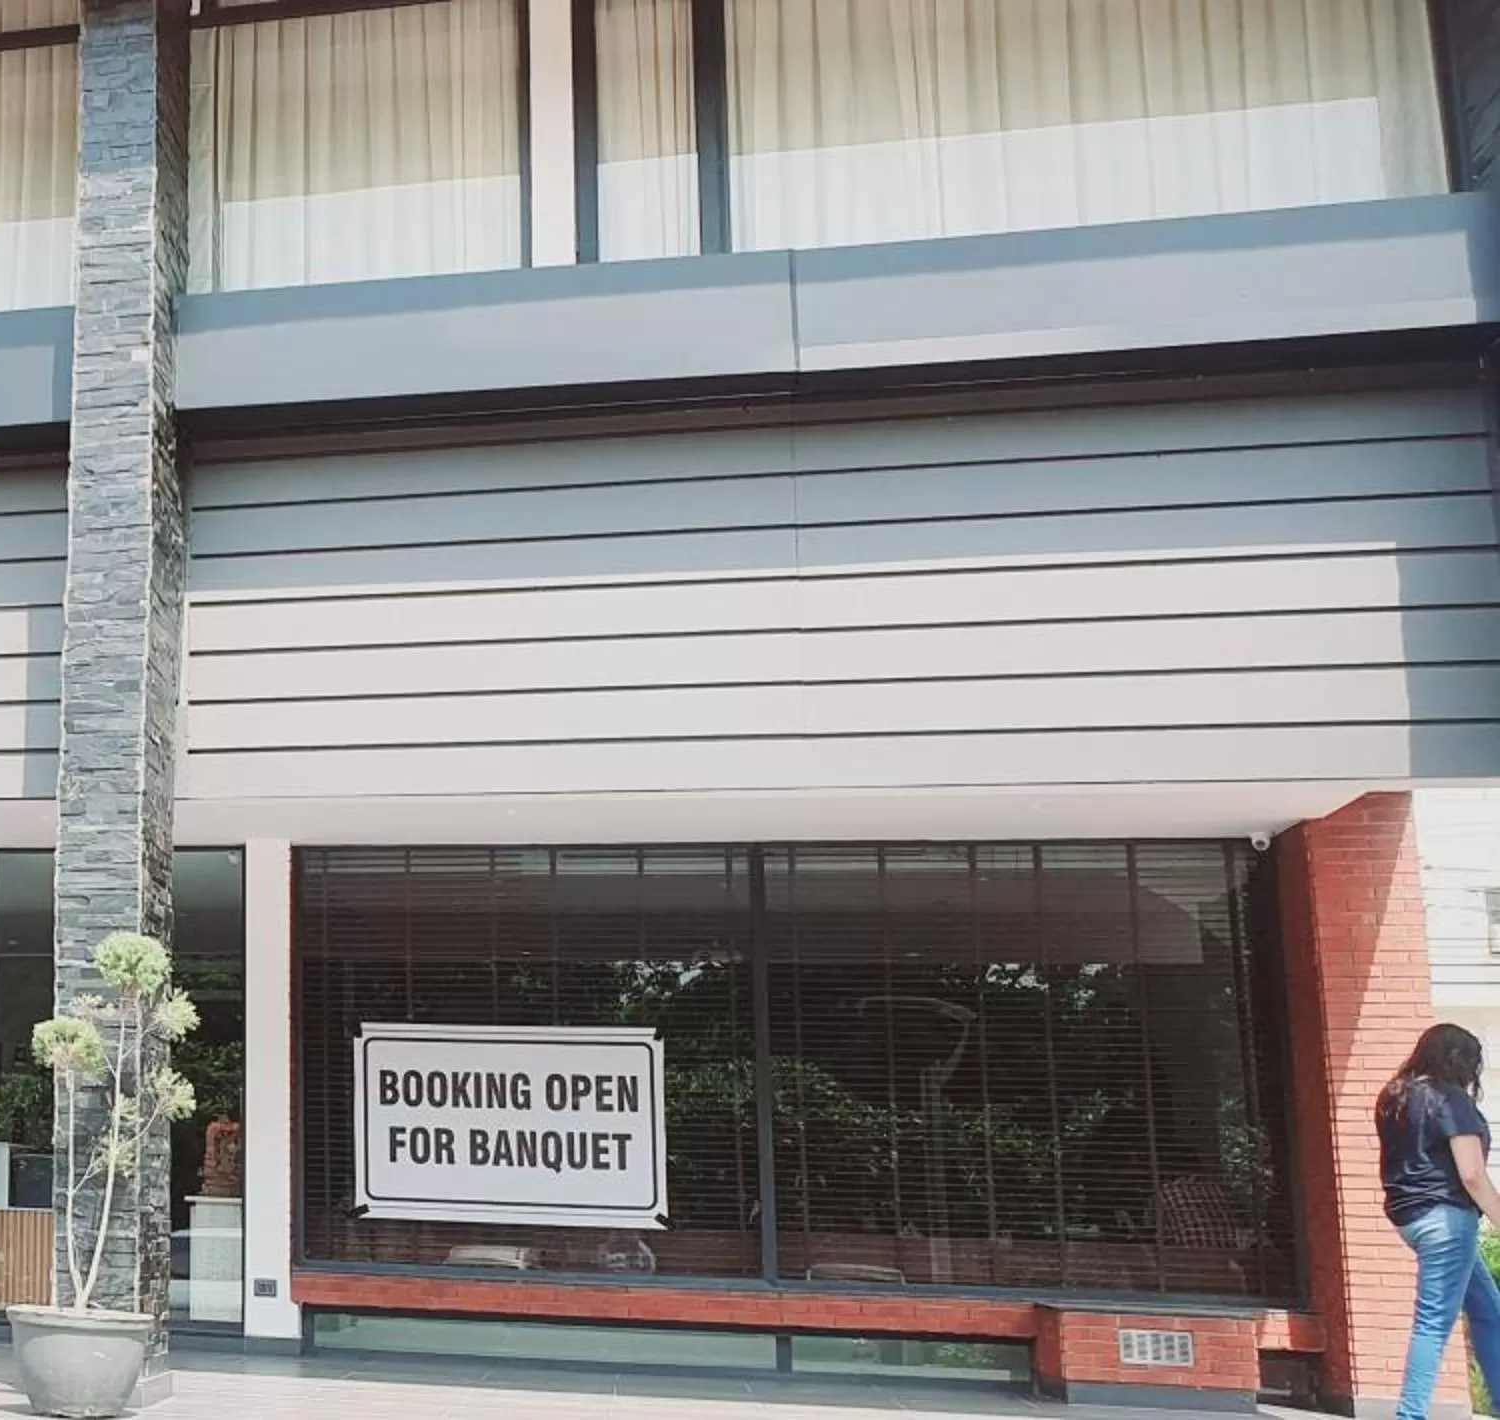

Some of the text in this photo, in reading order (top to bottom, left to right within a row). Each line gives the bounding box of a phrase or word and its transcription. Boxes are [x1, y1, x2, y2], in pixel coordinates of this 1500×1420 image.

[378, 1069, 639, 1113] BOOKING OPEN
[388, 1126, 633, 1175] FOR BANQUET
